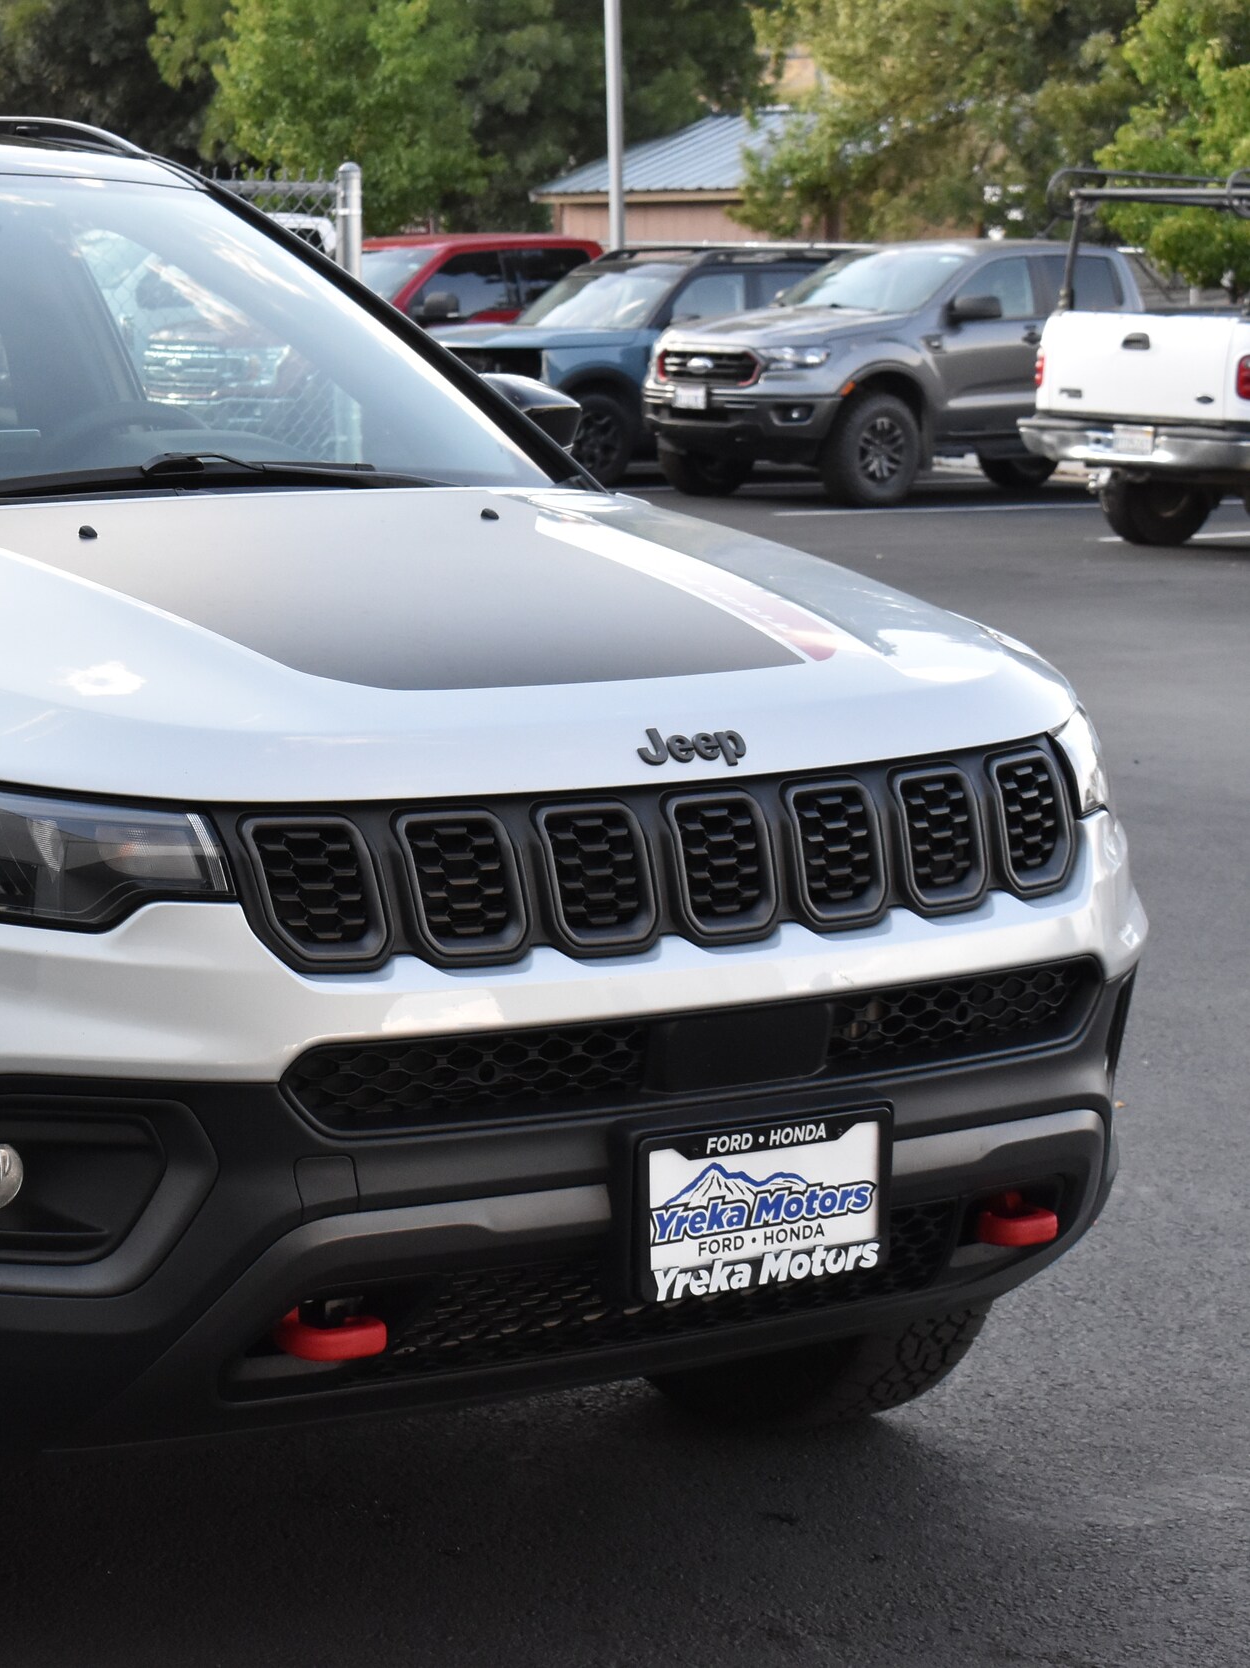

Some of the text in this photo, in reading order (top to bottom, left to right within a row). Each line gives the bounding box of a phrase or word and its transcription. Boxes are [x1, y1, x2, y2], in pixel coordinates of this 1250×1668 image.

[636, 727, 747, 767] Jeep
[705, 1122, 827, 1155] FORD HONDA
[652, 1183, 875, 1243] Yreka Motors
[698, 1222, 825, 1257] FORD HONDA
[652, 1241, 880, 1302] Yreka Motors
